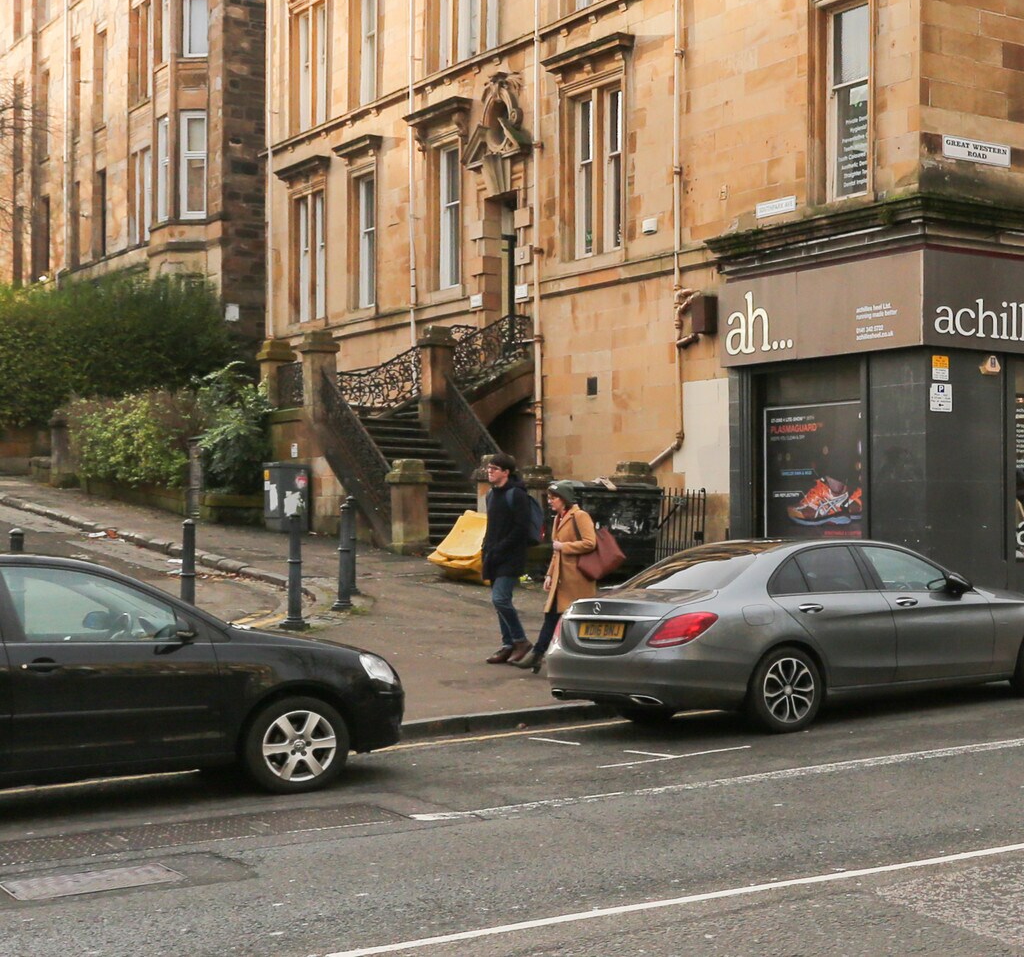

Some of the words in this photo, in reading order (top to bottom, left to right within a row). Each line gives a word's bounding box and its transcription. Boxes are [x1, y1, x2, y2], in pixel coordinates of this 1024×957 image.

[946, 139, 970, 149] GREAT
[972, 143, 1007, 155] WESTERN
[968, 151, 987, 159] ROAD
[726, 291, 793, 355] ah...
